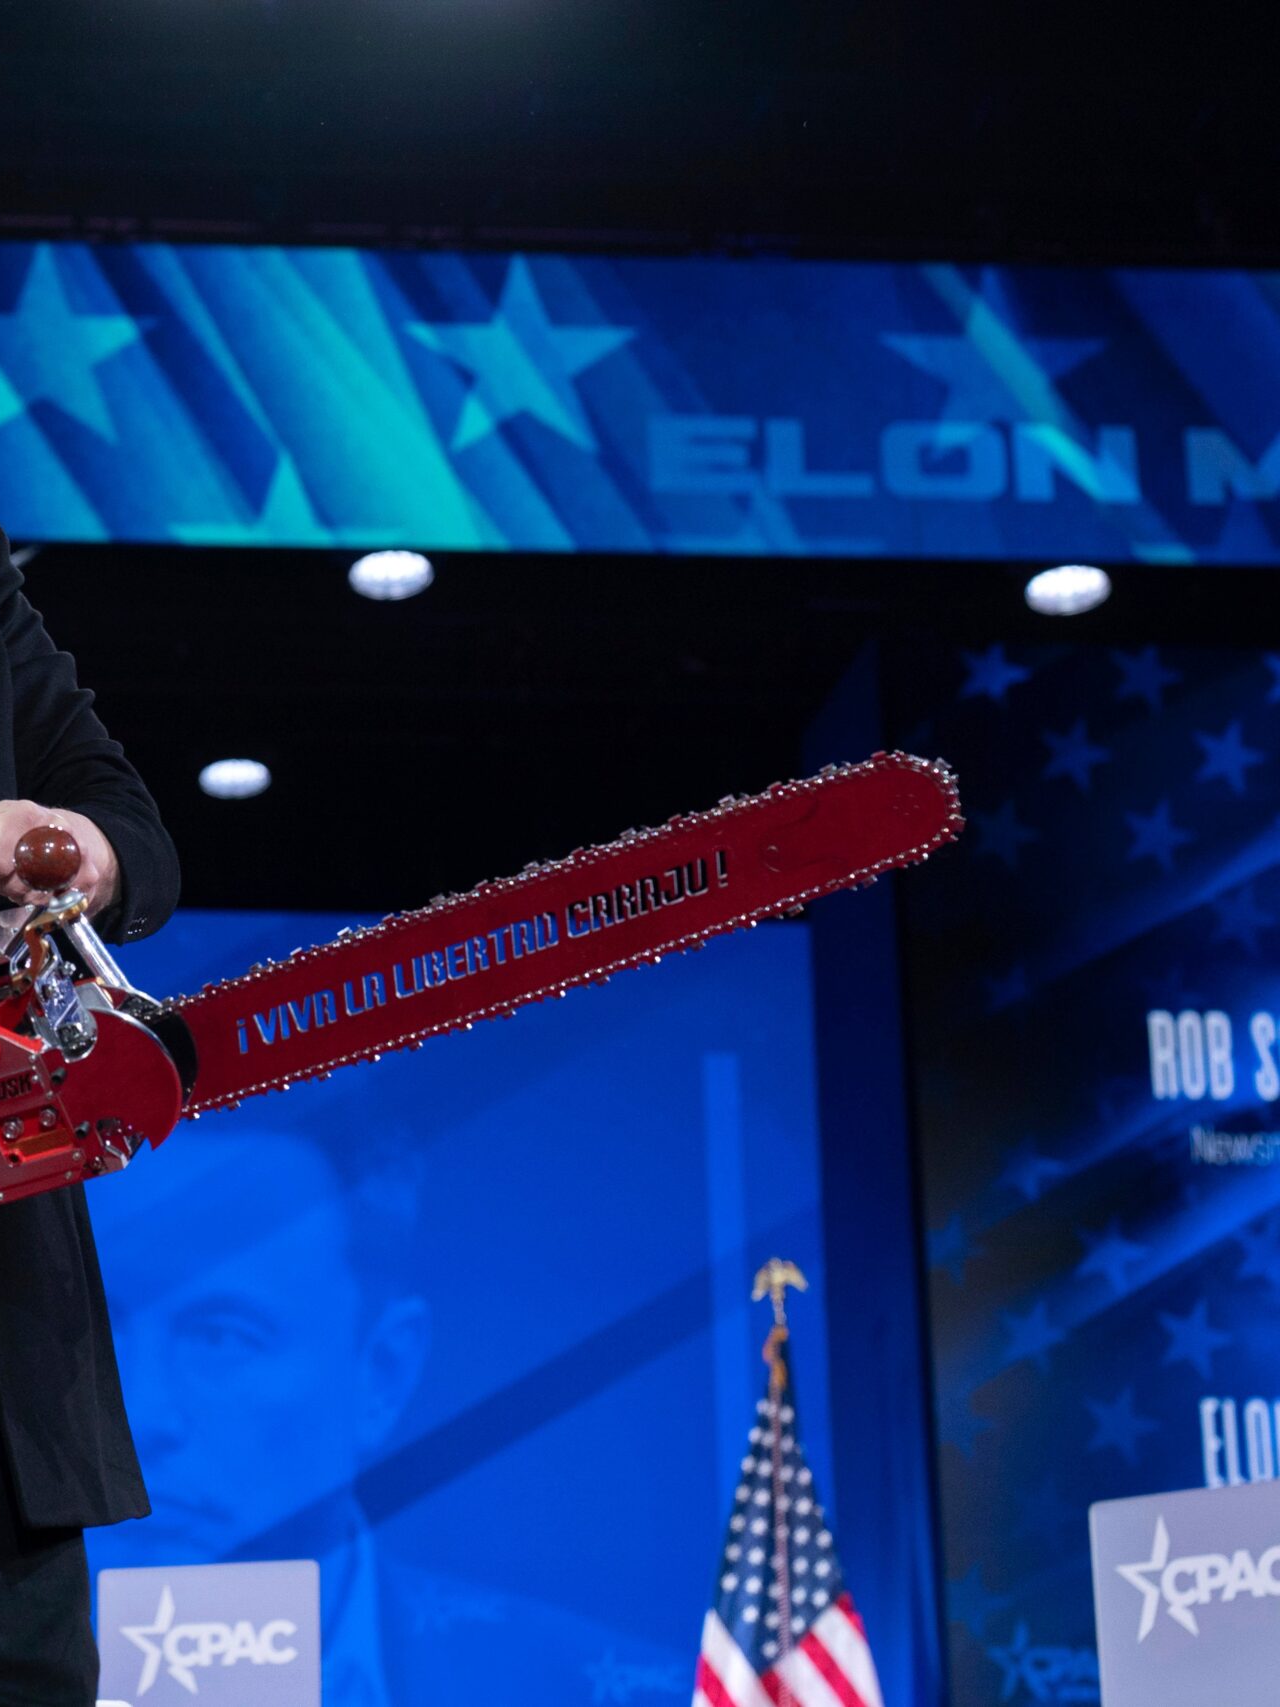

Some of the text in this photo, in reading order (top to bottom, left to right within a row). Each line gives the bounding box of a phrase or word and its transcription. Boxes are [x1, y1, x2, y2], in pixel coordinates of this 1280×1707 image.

[648, 415, 1140, 503] ELON
[344, 971, 387, 1018] LA
[1147, 1009, 1235, 1100] ROB
[1200, 1396, 1280, 1490] ELO
[163, 1620, 298, 1667] CPAC
